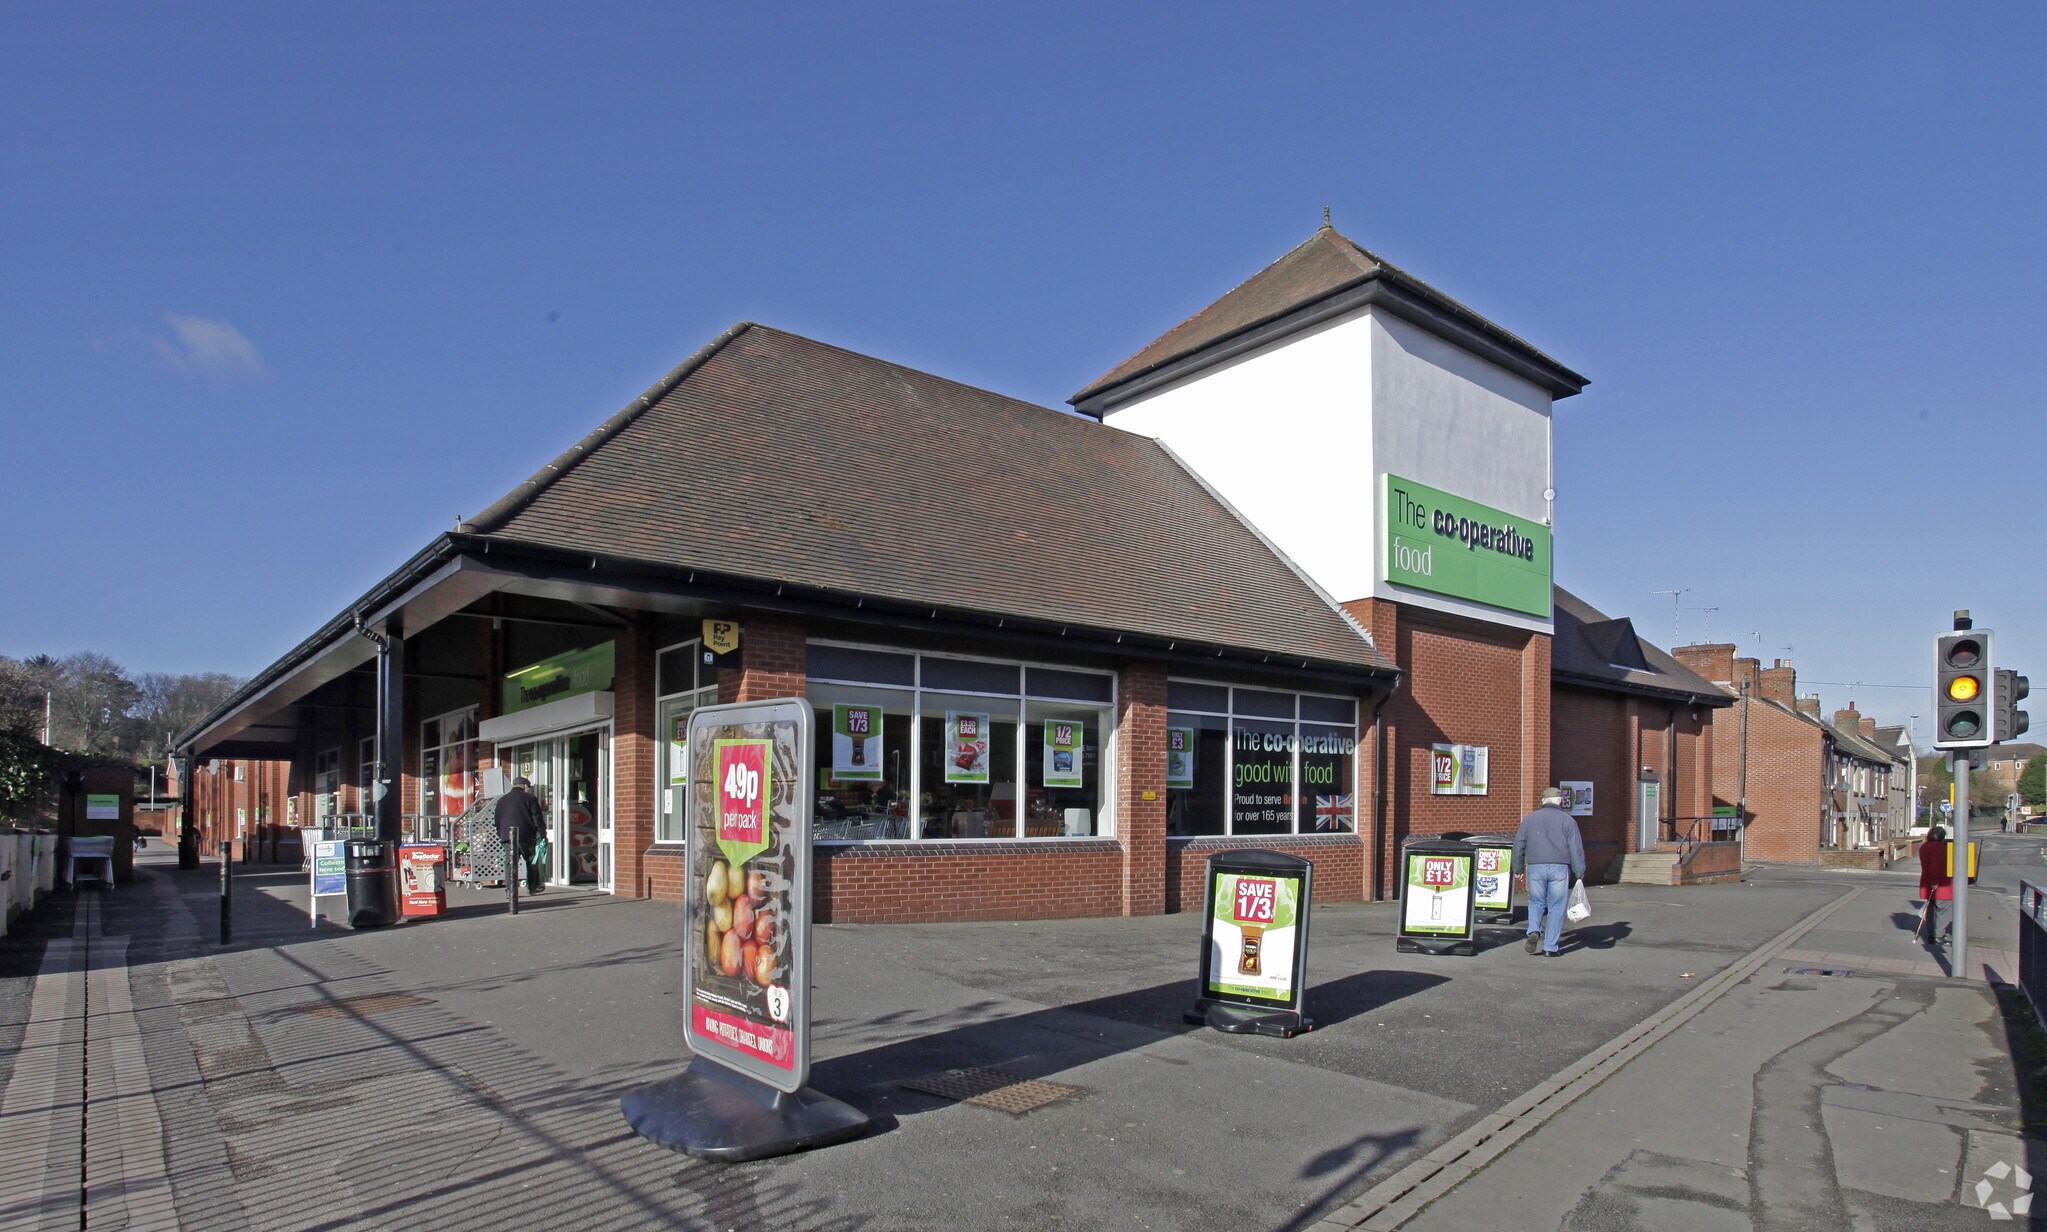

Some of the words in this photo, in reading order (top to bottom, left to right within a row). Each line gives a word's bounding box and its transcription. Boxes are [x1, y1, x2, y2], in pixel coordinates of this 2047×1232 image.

[1393, 488, 1426, 529] The
[1393, 536, 1433, 576] food
[713, 634, 725, 642] Pay
[713, 640, 731, 648] Point
[848, 710, 868, 719] SAVE
[848, 718, 868, 732] 1/3
[960, 726, 976, 734] EACH
[1056, 725, 1072, 738] 1/2
[1055, 736, 1072, 745] PRICE
[1171, 737, 1184, 749] £3
[1234, 726, 1260, 751] The
[1436, 756, 1451, 773] 1/2
[1235, 759, 1271, 788] good
[1273, 760, 1294, 783] wit
[1304, 761, 1333, 784] food
[724, 762, 759, 808] 49p
[1235, 793, 1255, 805] Proud
[1255, 794, 1262, 805] to
[1263, 795, 1282, 805] serve
[723, 811, 738, 830] per
[738, 810, 757, 831] pack
[1245, 812, 1259, 821] over
[1261, 810, 1275, 821] 165
[1426, 861, 1453, 871] ONLY
[1478, 857, 1496, 870] £3
[1425, 870, 1452, 883] £13
[1238, 882, 1272, 897] SAVE
[1237, 896, 1272, 920] 1/3
[773, 997, 782, 1017] 3
